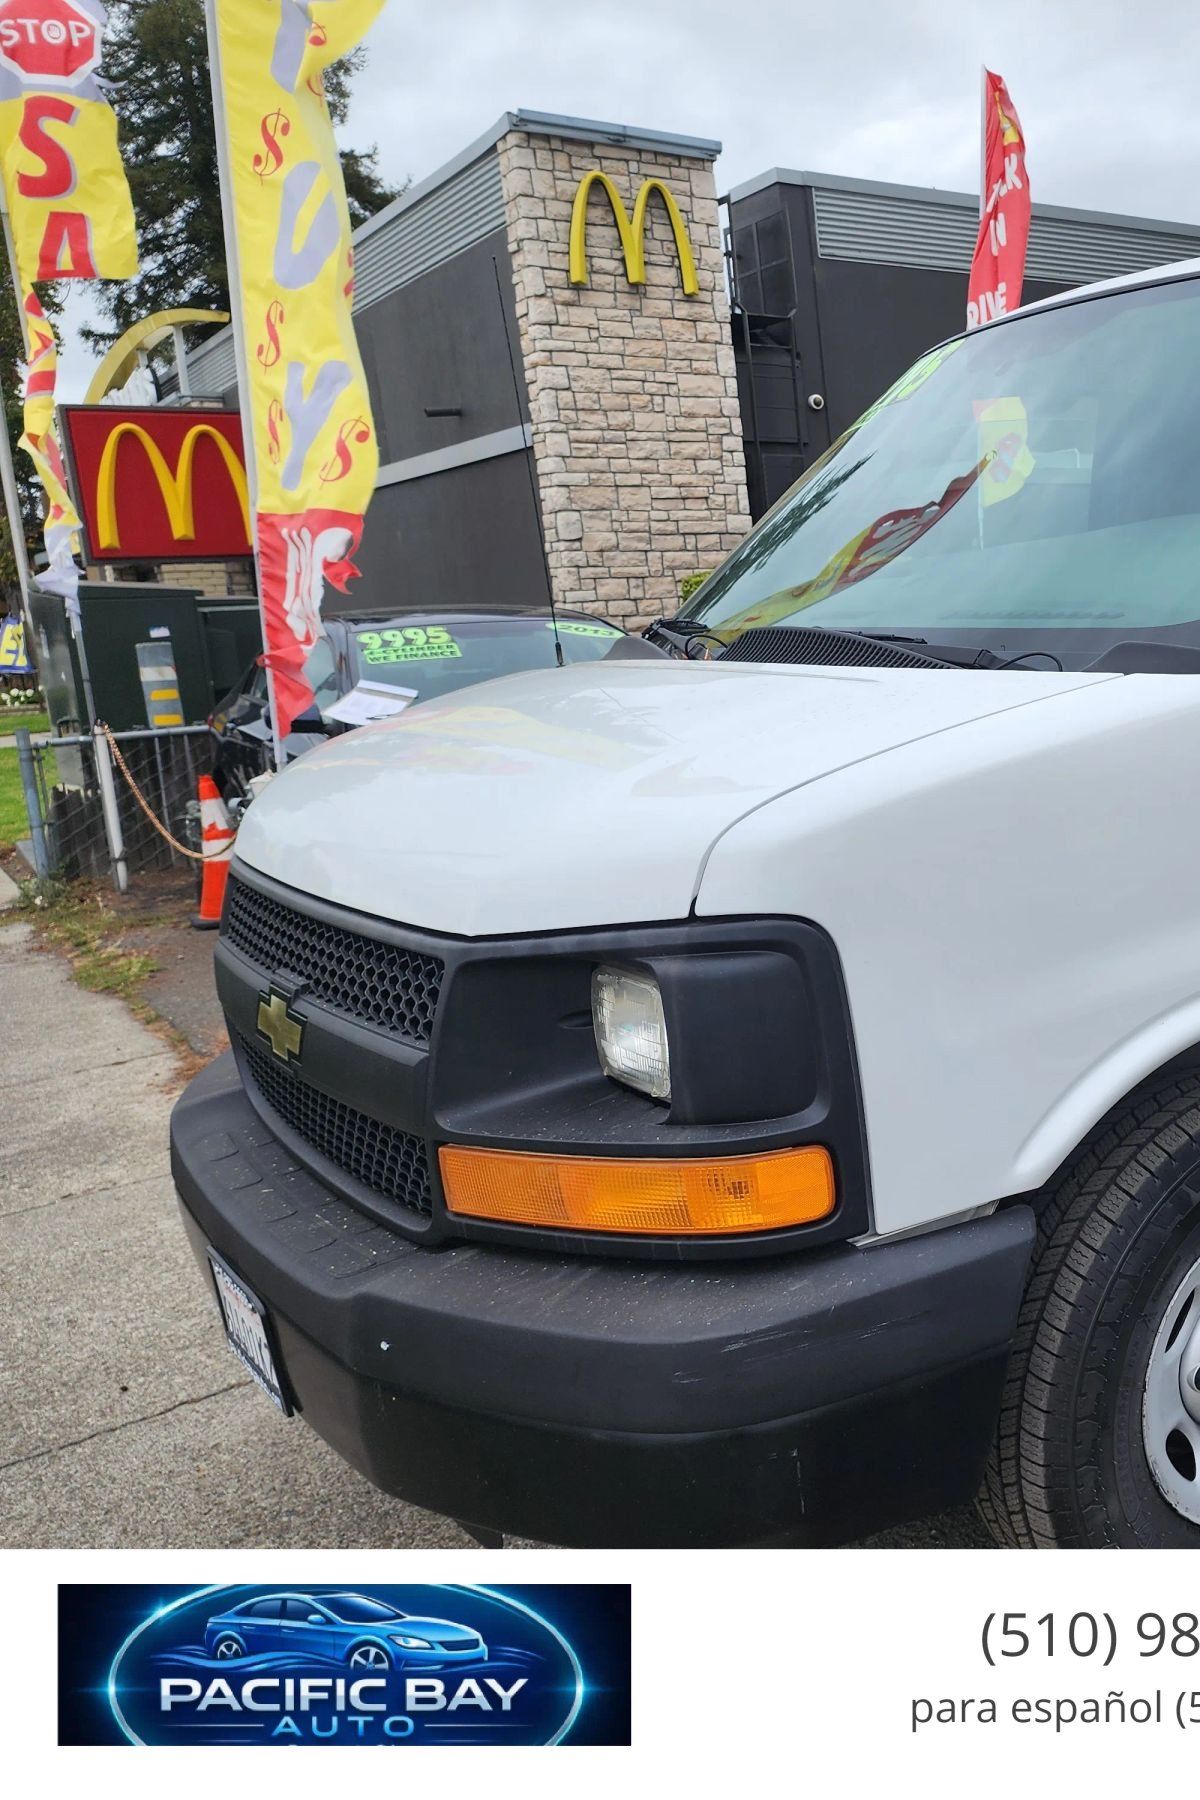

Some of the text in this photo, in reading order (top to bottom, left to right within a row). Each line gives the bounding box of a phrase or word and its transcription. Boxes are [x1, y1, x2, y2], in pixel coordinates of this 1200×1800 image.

[0, 18, 91, 48] STOP
[569, 169, 699, 296] M
[966, 281, 1007, 331] RIVE
[356, 626, 453, 649] 9995
[395, 650, 457, 660] FINANCE
